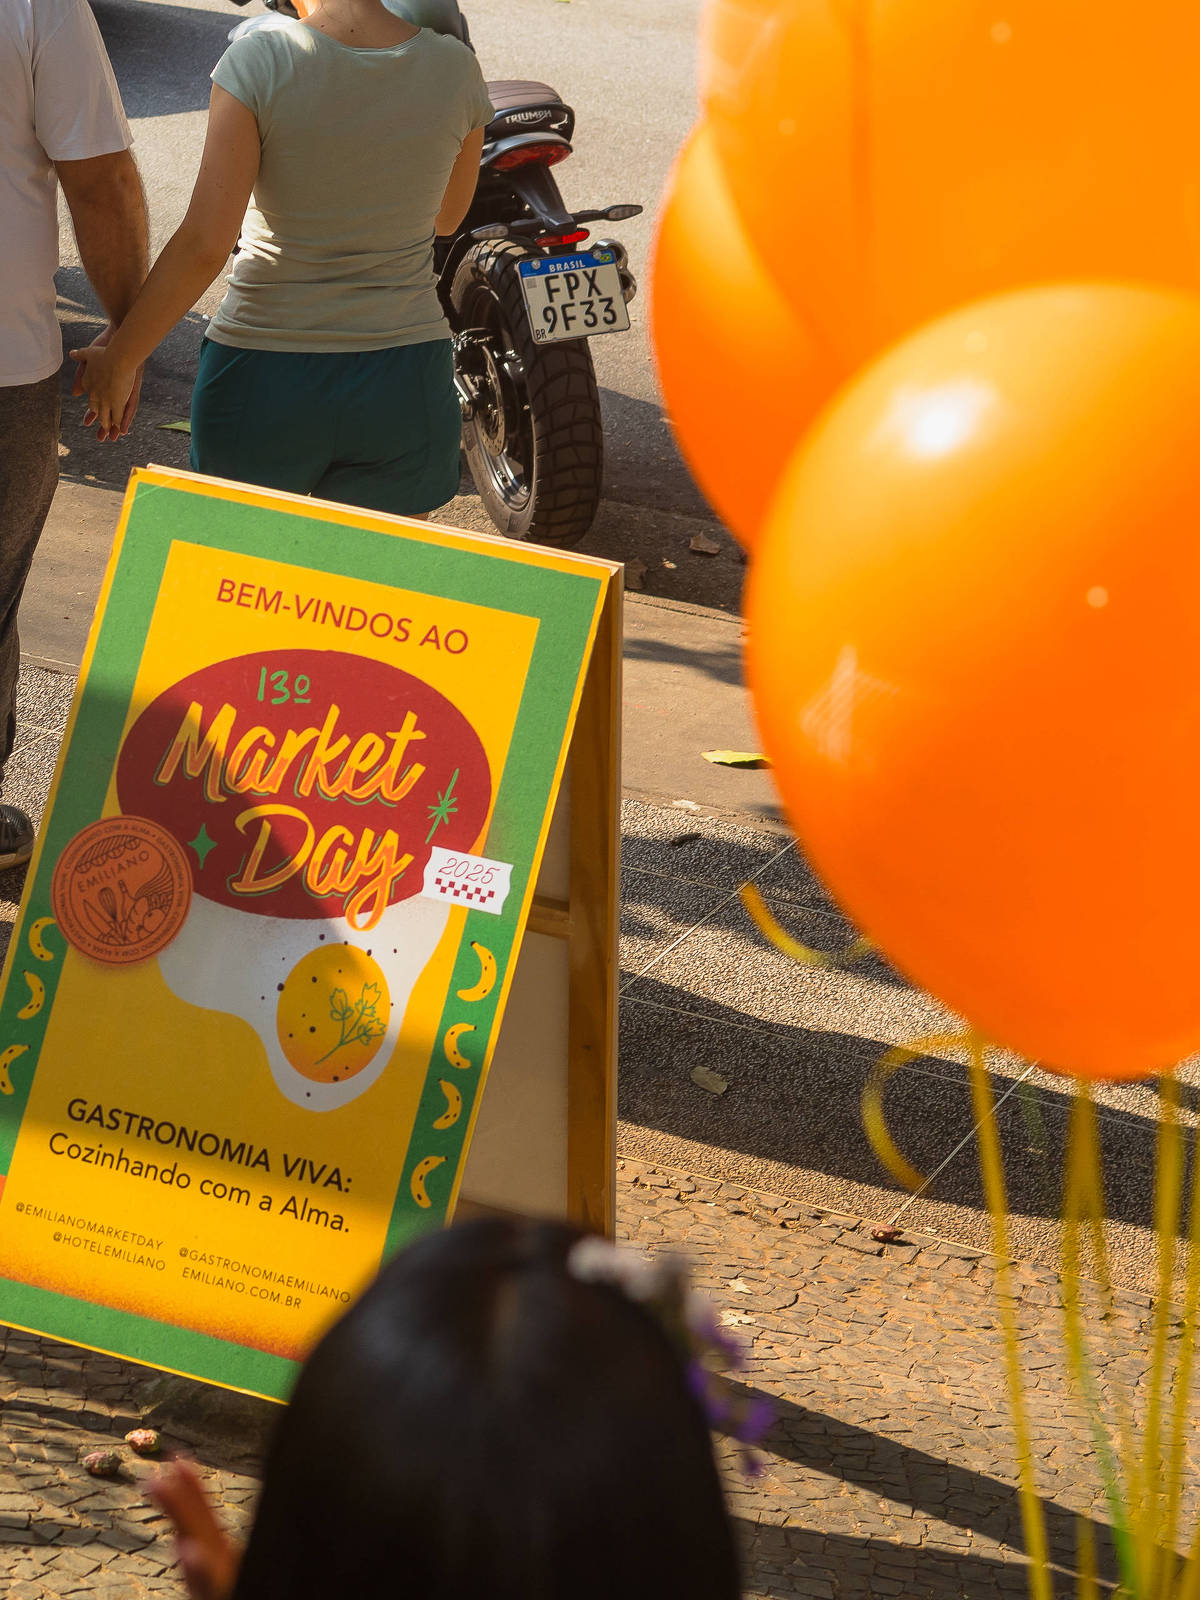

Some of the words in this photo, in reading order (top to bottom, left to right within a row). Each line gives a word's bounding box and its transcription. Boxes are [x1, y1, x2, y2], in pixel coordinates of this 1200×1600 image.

[505, 109, 552, 124] TRIUMPH
[544, 269, 602, 303] FPX
[548, 260, 586, 272] BRASIL
[535, 329, 547, 340] BR
[542, 297, 617, 333] 9F33
[217, 578, 412, 643] BEM-VINDOS
[420, 624, 469, 655] AO
[155, 700, 427, 804] Market
[77, 850, 150, 893] EMILIANO
[230, 803, 415, 932] Day
[438, 857, 502, 885] 2025
[67, 1098, 270, 1172] GASTRONOMIA
[283, 1153, 352, 1193] VIVA:
[49, 1132, 191, 1189] Cozinhando
[200, 1179, 251, 1206] com
[258, 1195, 273, 1212] a
[279, 1195, 349, 1233] Alma.
[16, 1202, 164, 1251] @EMILIANOMARKETDAY
[53, 1231, 166, 1271] @HOTELEMILIANO
[179, 1247, 351, 1304] @GASTRONOMIAEMILIANO
[182, 1267, 302, 1309] EMILIANO.COM.BR
